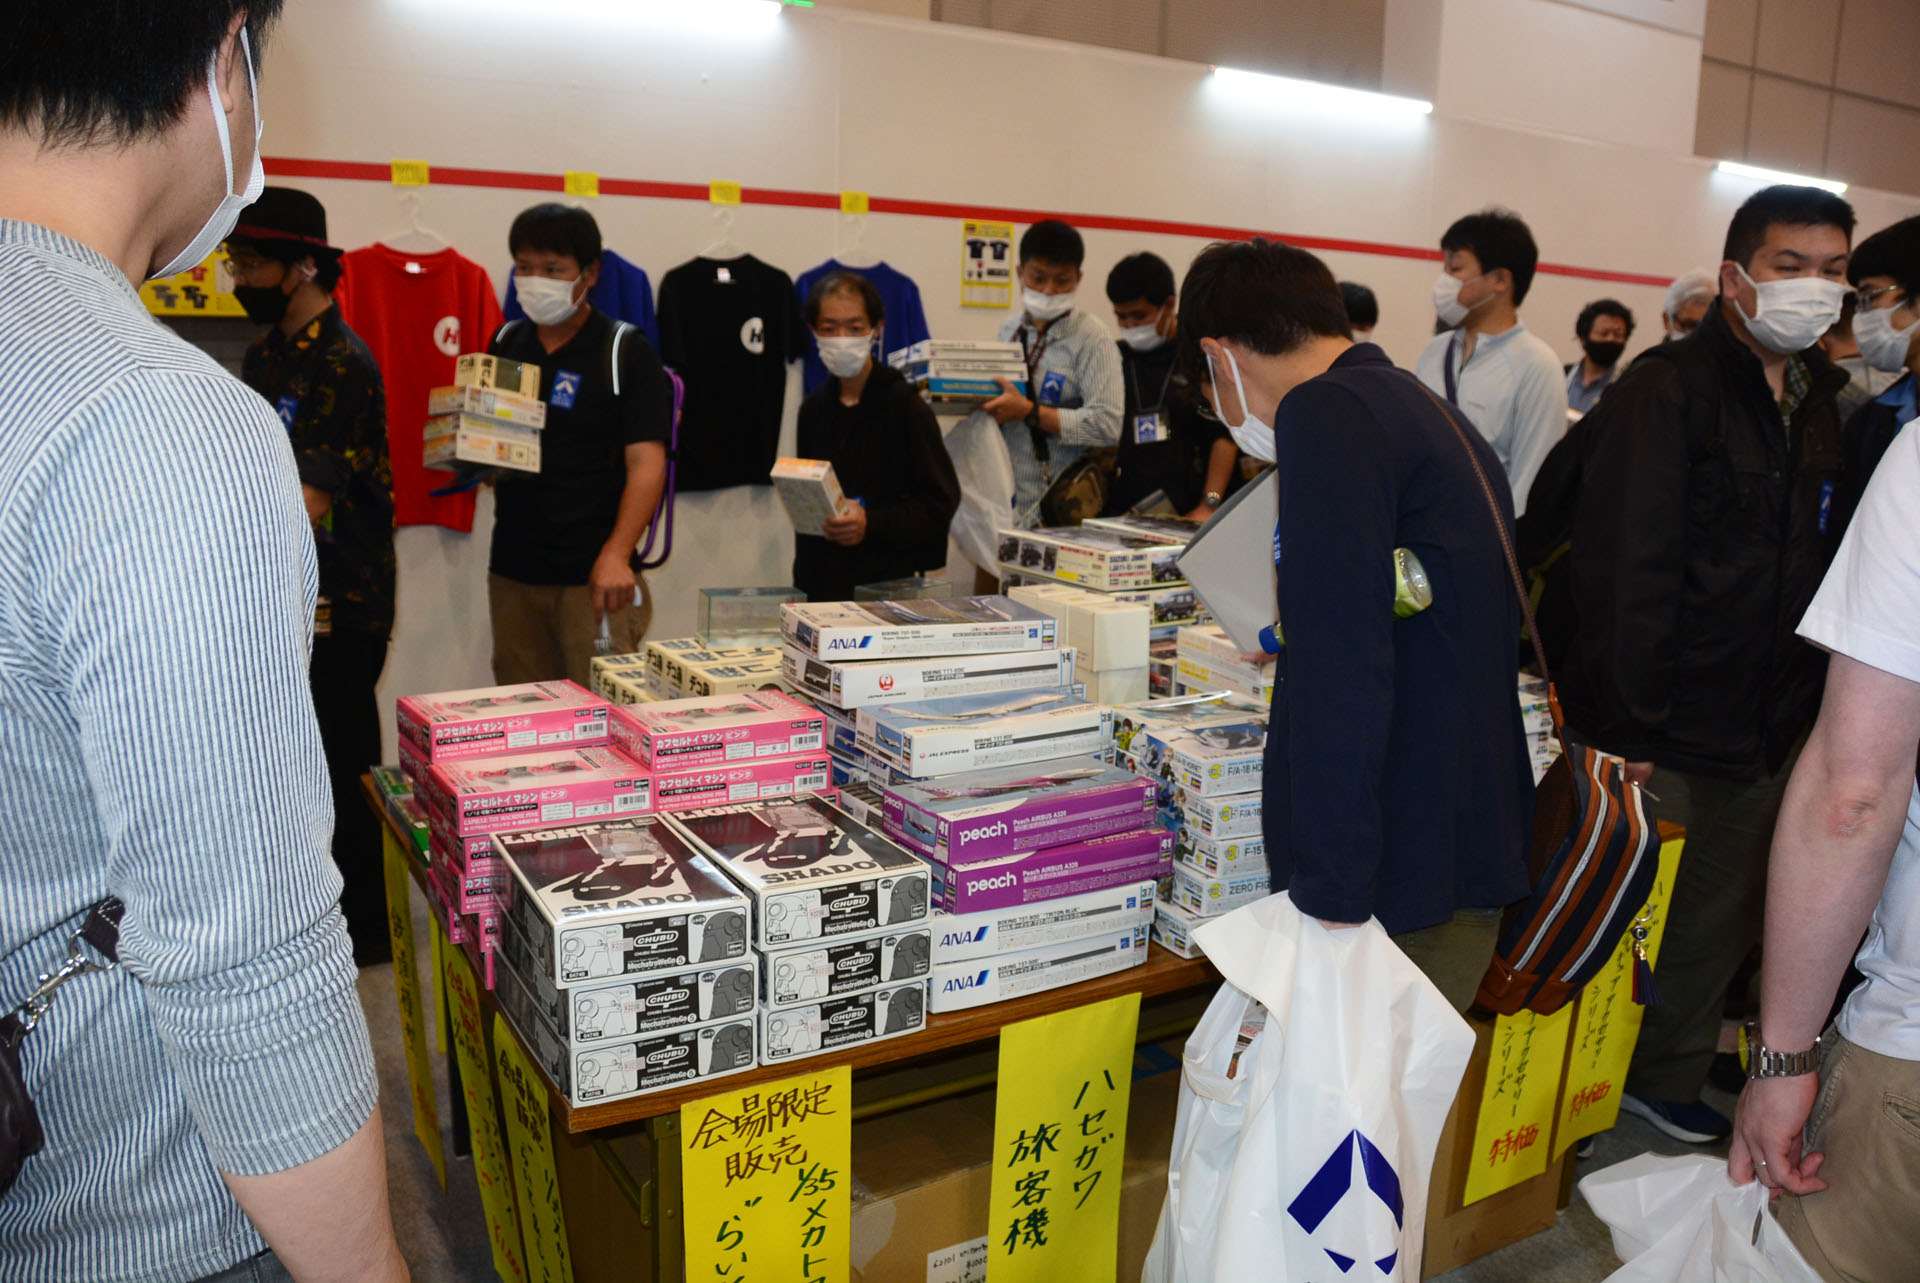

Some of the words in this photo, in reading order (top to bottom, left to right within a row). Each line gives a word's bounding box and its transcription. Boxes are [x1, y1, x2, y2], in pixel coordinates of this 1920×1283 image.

[828, 638, 857, 650] ANA
[1144, 786, 1155, 798] 41
[674, 802, 765, 821] LIGHT
[767, 799, 794, 807] and
[884, 795, 904, 811] peach
[501, 825, 600, 845] LIGHT
[939, 821, 948, 836] 41
[959, 821, 1008, 846] peach
[1161, 838, 1173, 849] 41
[760, 861, 878, 884] SHADO
[946, 870, 956, 885] 41
[966, 872, 1017, 896] peach
[1142, 888, 1152, 897] 37
[1229, 884, 1253, 895] ZERO
[561, 893, 692, 917] SHADO
[834, 898, 865, 908] CHUBU
[637, 933, 675, 945] CHUBU
[939, 931, 972, 947] ANA
[840, 956, 870, 967] CHUBU
[943, 975, 974, 993] ANA
[649, 992, 685, 1003] CHUBU
[833, 1011, 863, 1022] CHUBU
[650, 1049, 685, 1061] CHUBU
[1494, 1026, 1516, 1099] シリーズ
[1568, 1079, 1611, 1122] 特価
[689, 1081, 837, 1149] 会場限定
[1073, 1069, 1116, 1210] ハセガワ
[1489, 1122, 1540, 1168] 特価
[725, 1134, 808, 1188] 販売
[788, 1162, 839, 1203] 1/35
[1003, 1122, 1062, 1255] 旅客機
